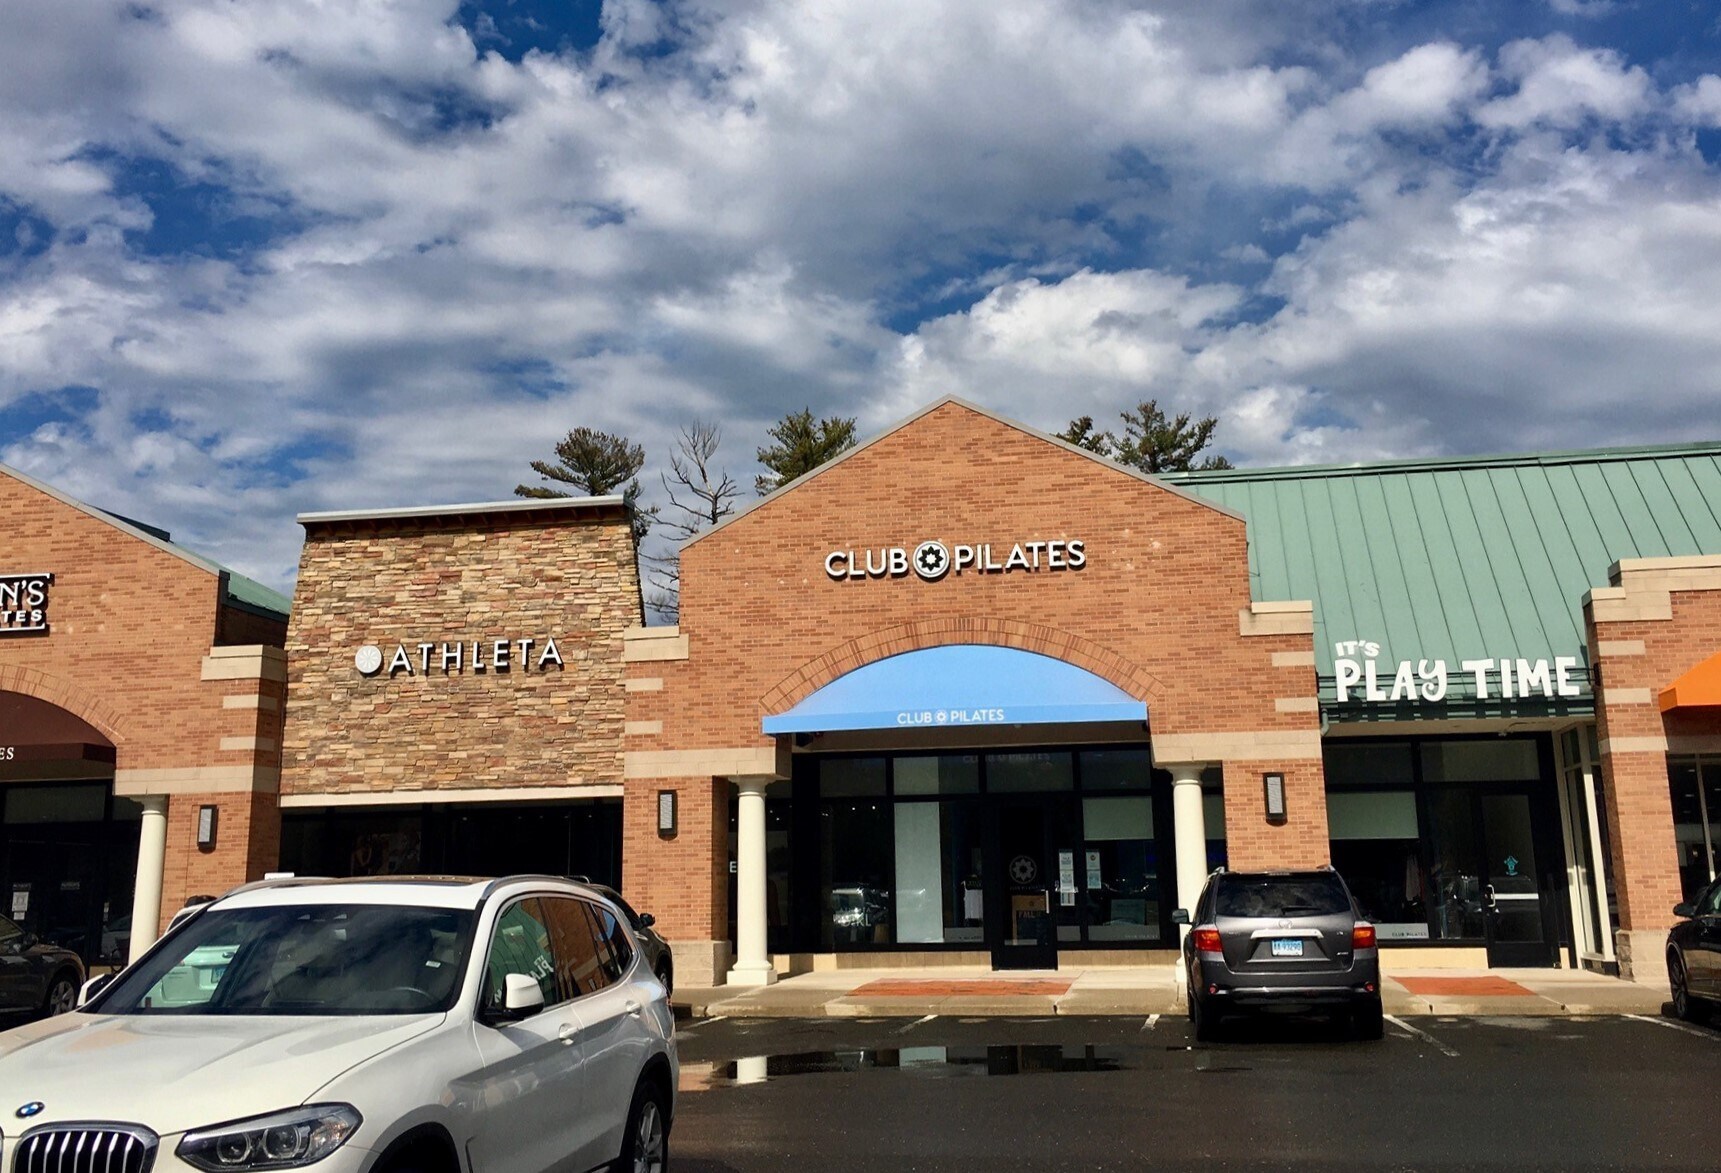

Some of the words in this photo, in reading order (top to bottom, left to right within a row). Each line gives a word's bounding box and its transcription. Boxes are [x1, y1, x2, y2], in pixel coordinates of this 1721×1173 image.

[825, 548, 908, 578] CLUB
[955, 540, 1086, 572] PILATES
[387, 638, 563, 672] ATHLETA
[1335, 640, 1380, 657] IT'S
[1335, 658, 1448, 703] PLAY
[1462, 656, 1580, 700] TIME
[897, 712, 933, 725] CLUB
[950, 709, 1005, 724] PILATES
